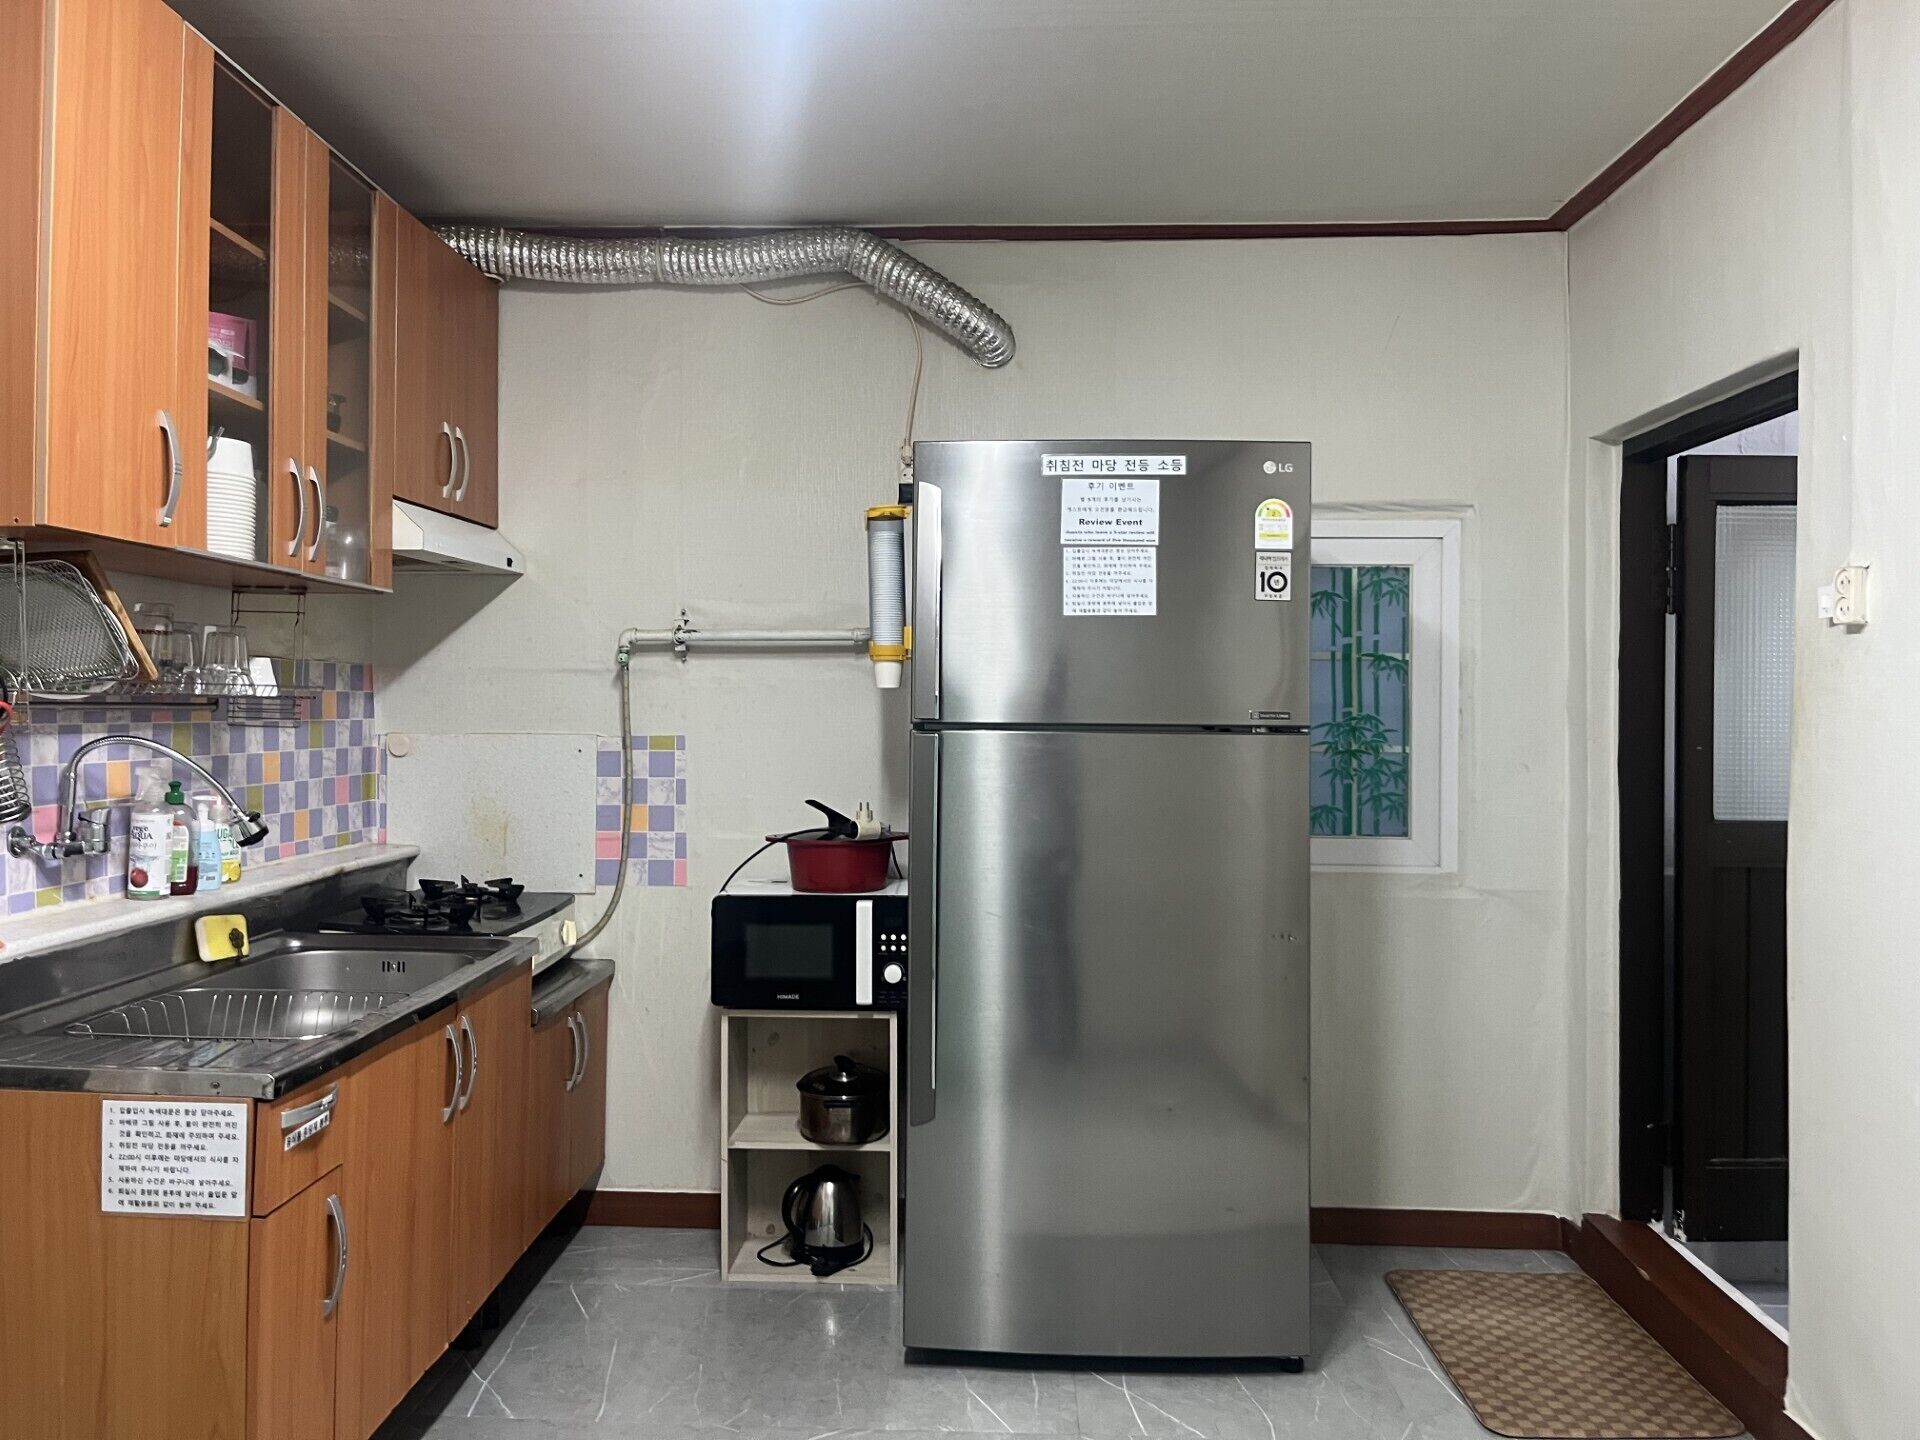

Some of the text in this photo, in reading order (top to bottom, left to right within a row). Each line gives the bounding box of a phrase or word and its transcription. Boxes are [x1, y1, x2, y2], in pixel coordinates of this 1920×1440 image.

[1046, 459, 1183, 472] 취침전 마당 전등 소등
[1278, 463, 1294, 473] LG
[1109, 482, 1134, 490] 이벤트
